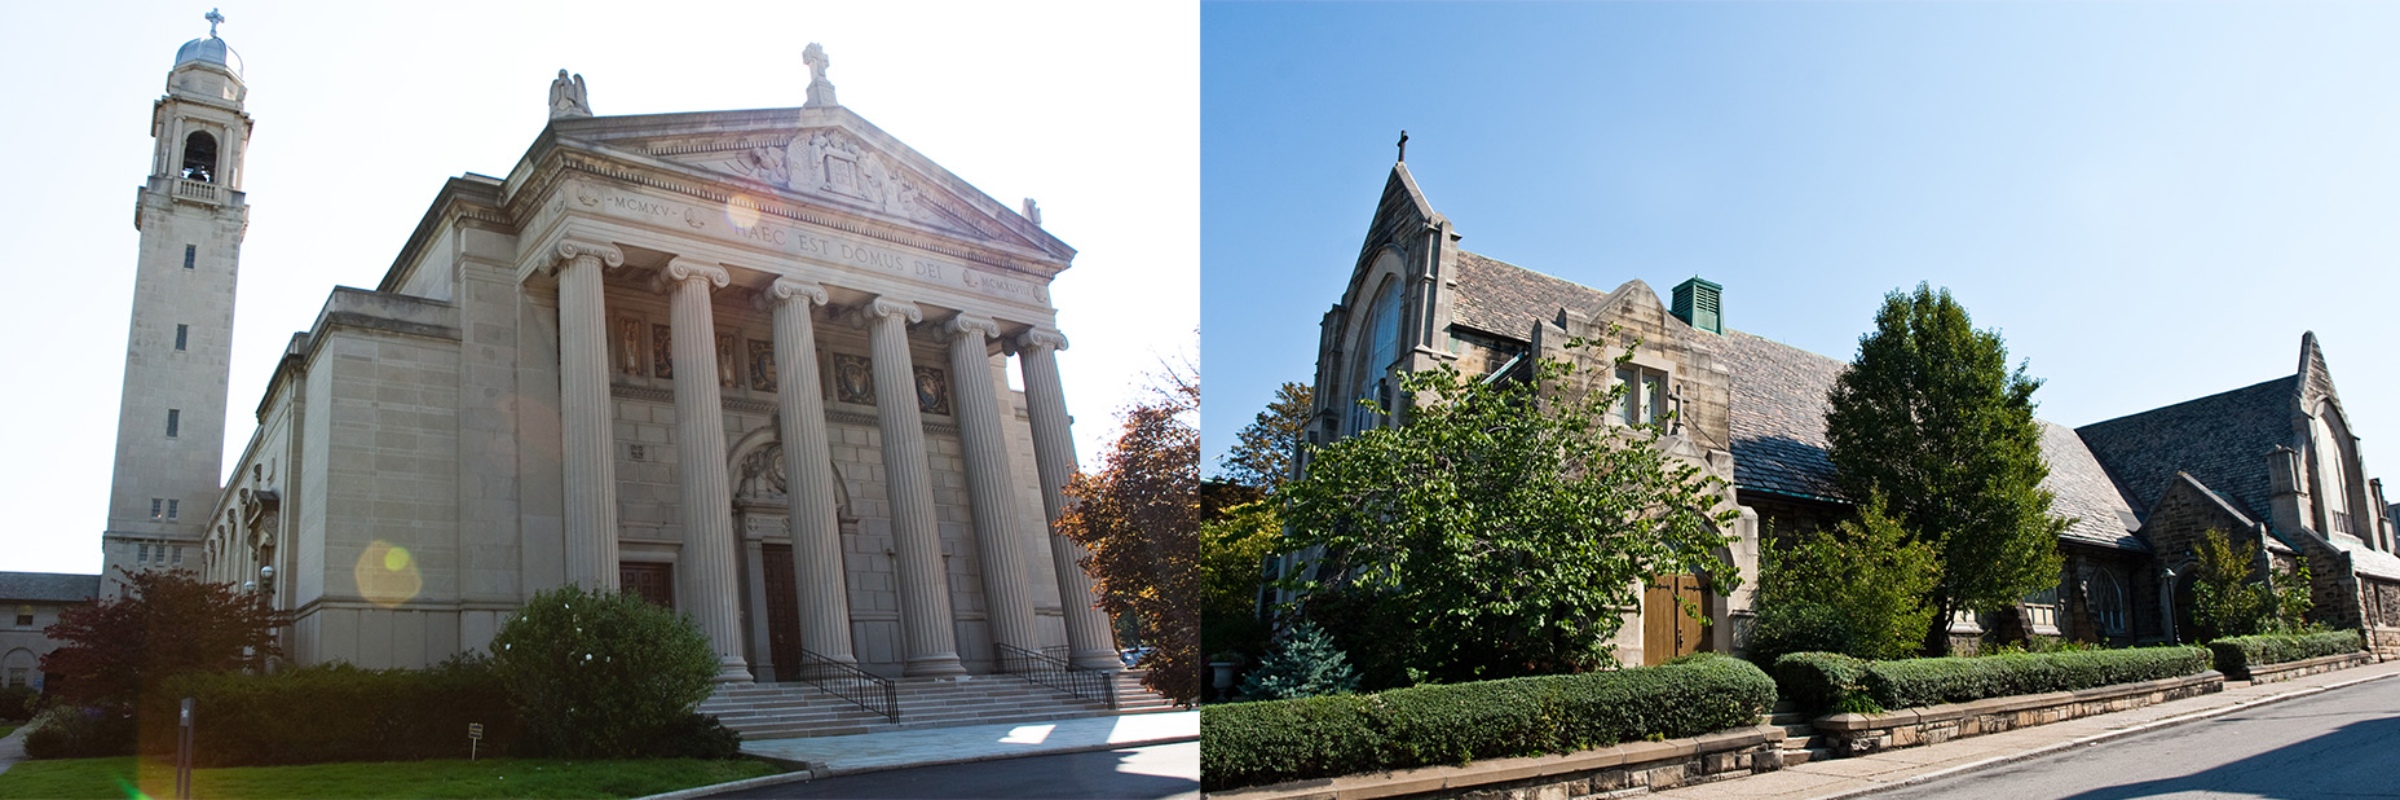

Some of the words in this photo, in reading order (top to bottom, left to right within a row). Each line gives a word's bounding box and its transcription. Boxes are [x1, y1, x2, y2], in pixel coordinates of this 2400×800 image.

[735, 225, 785, 246] HAEC
[799, 234, 828, 255] EST
[841, 244, 903, 271] DOMUS
[914, 261, 942, 279] DEI
